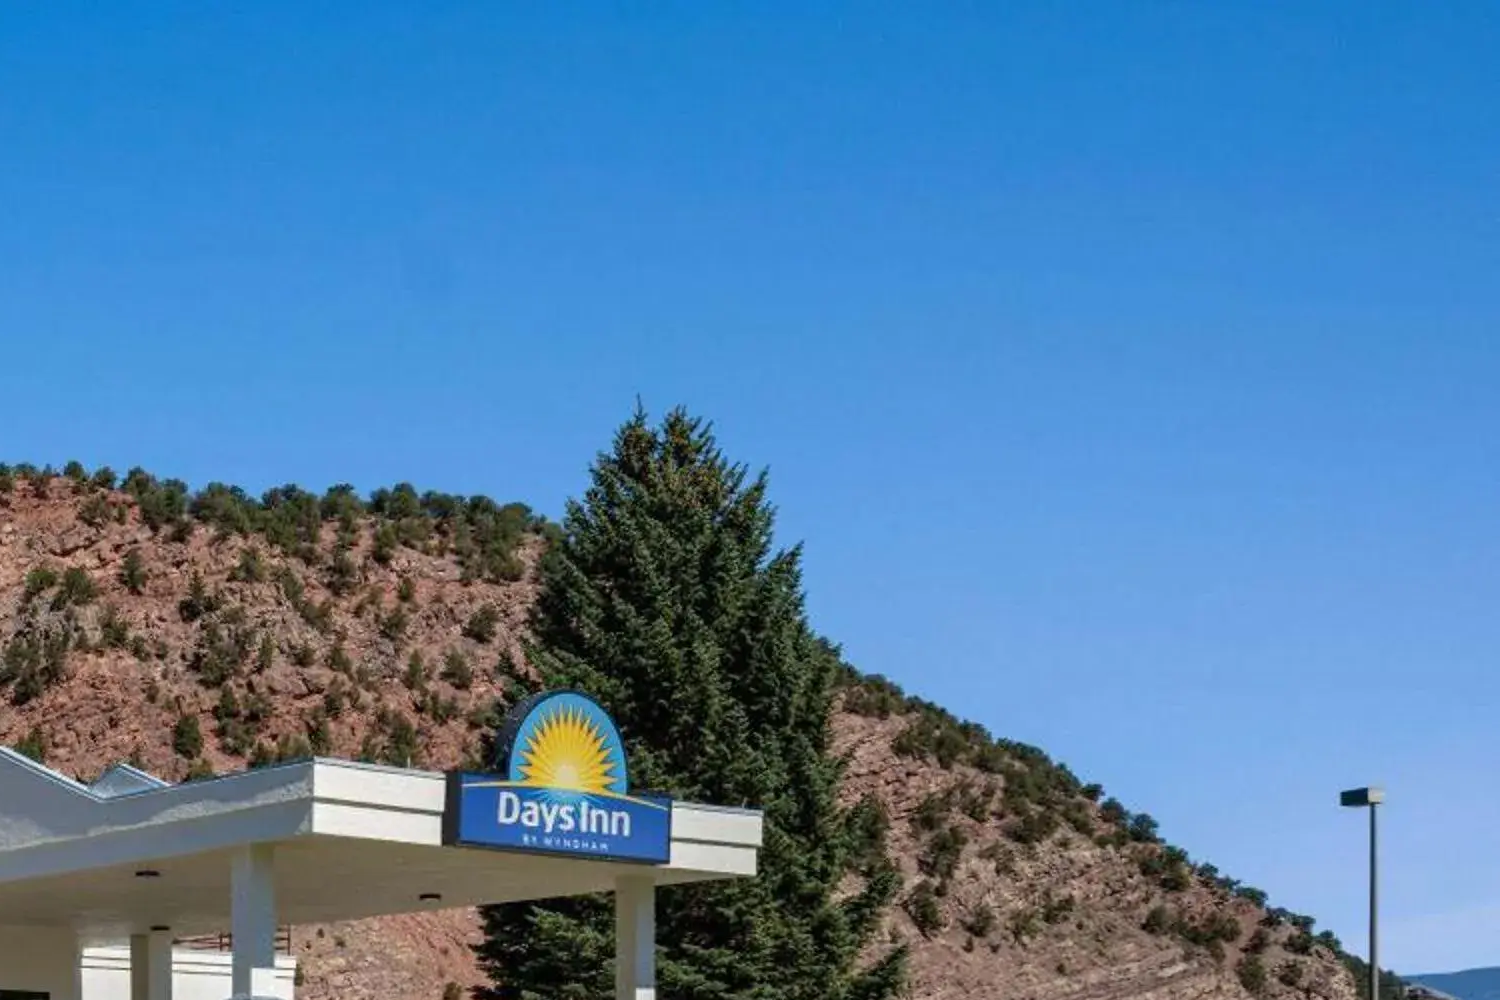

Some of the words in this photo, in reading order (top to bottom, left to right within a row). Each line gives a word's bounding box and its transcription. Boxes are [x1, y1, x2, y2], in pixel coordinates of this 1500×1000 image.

[498, 791, 575, 833] Days
[579, 801, 631, 837] Inn
[522, 833, 538, 846] BY
[543, 836, 609, 852] WYNDHAM
